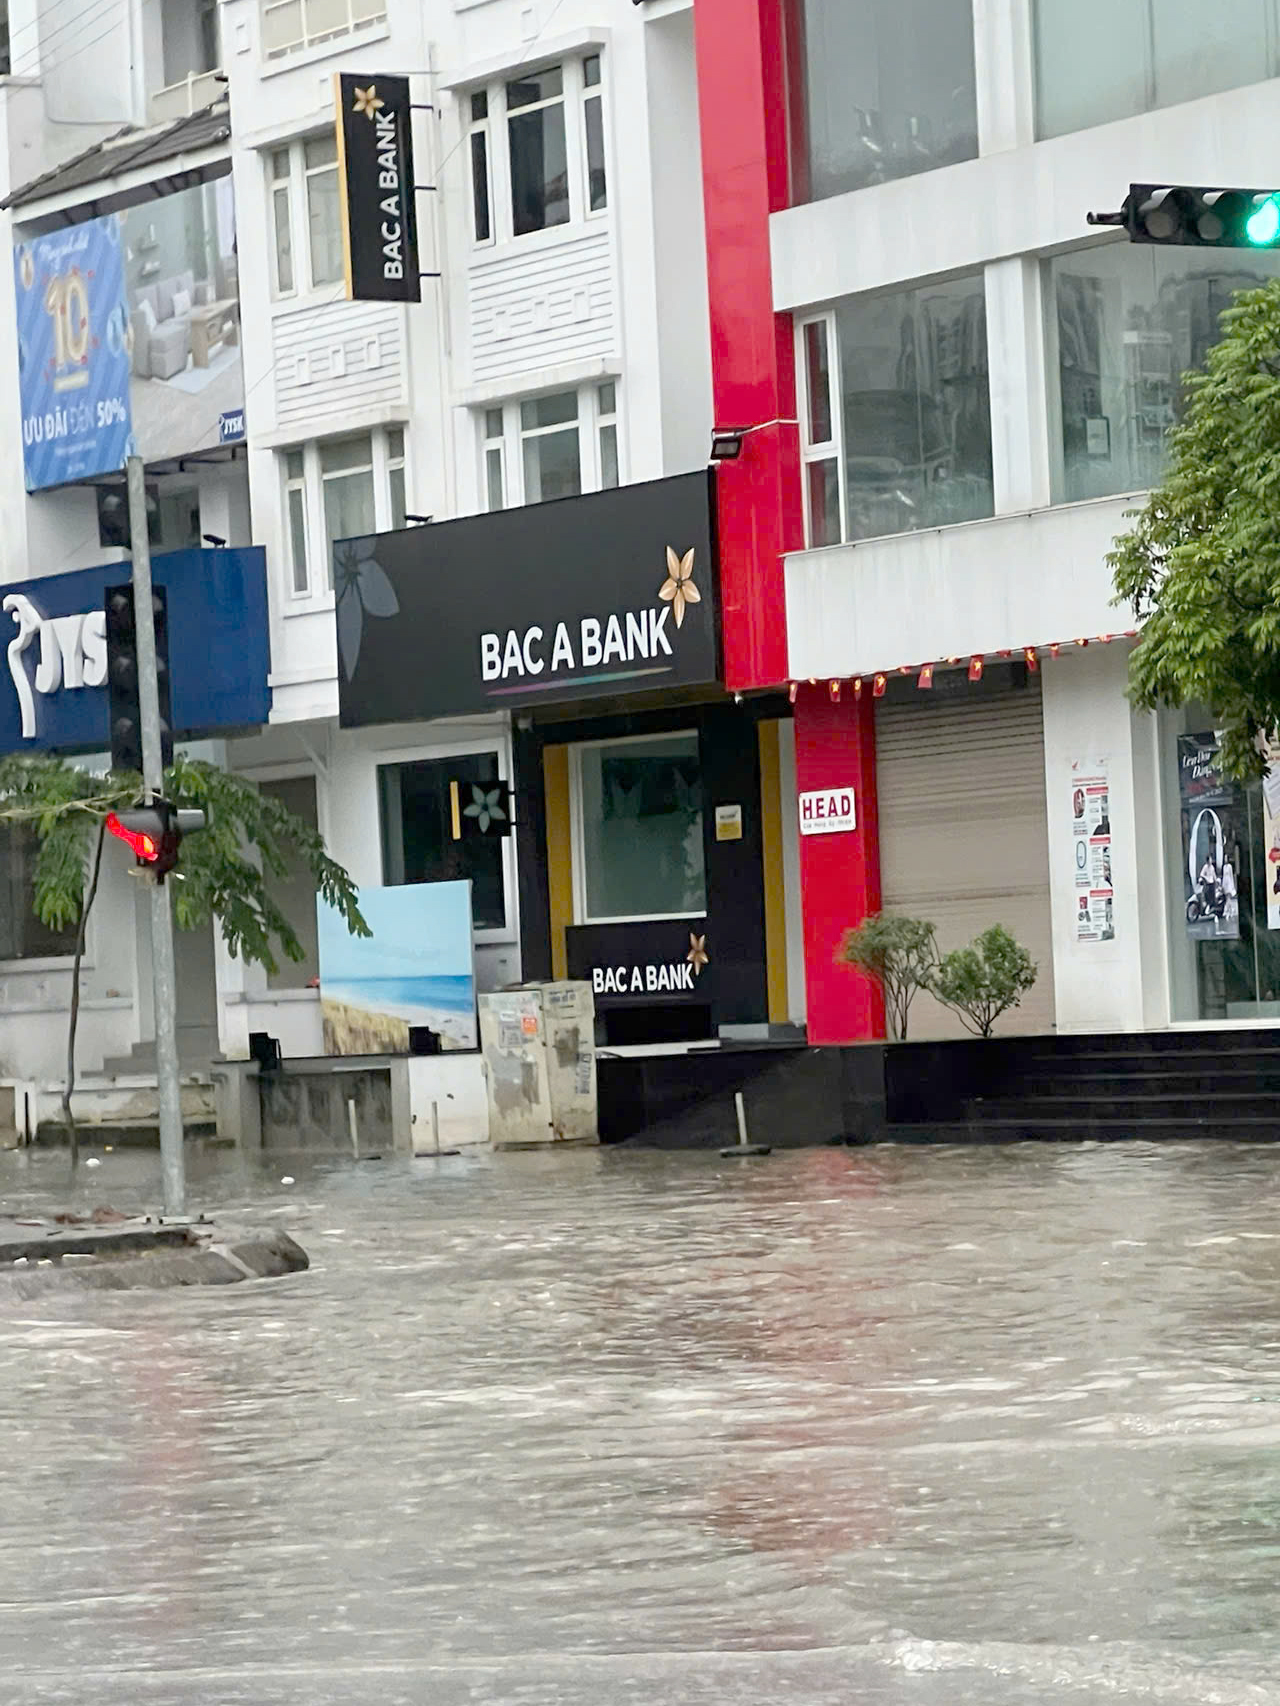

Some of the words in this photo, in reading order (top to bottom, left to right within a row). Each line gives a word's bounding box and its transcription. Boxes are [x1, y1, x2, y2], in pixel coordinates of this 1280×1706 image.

[375, 111, 399, 190] BANK
[379, 194, 401, 217] A
[381, 221, 404, 280] BAC
[46, 271, 89, 368] 10
[97, 397, 127, 428] 50%
[224, 414, 244, 435] JYSK
[480, 626, 545, 682] BAC
[550, 622, 576, 672] A
[580, 605, 674, 667] BANK
[802, 795, 851, 820] HEAD
[592, 966, 628, 994] BAC
[630, 965, 644, 993] A
[645, 963, 695, 992] BANK
